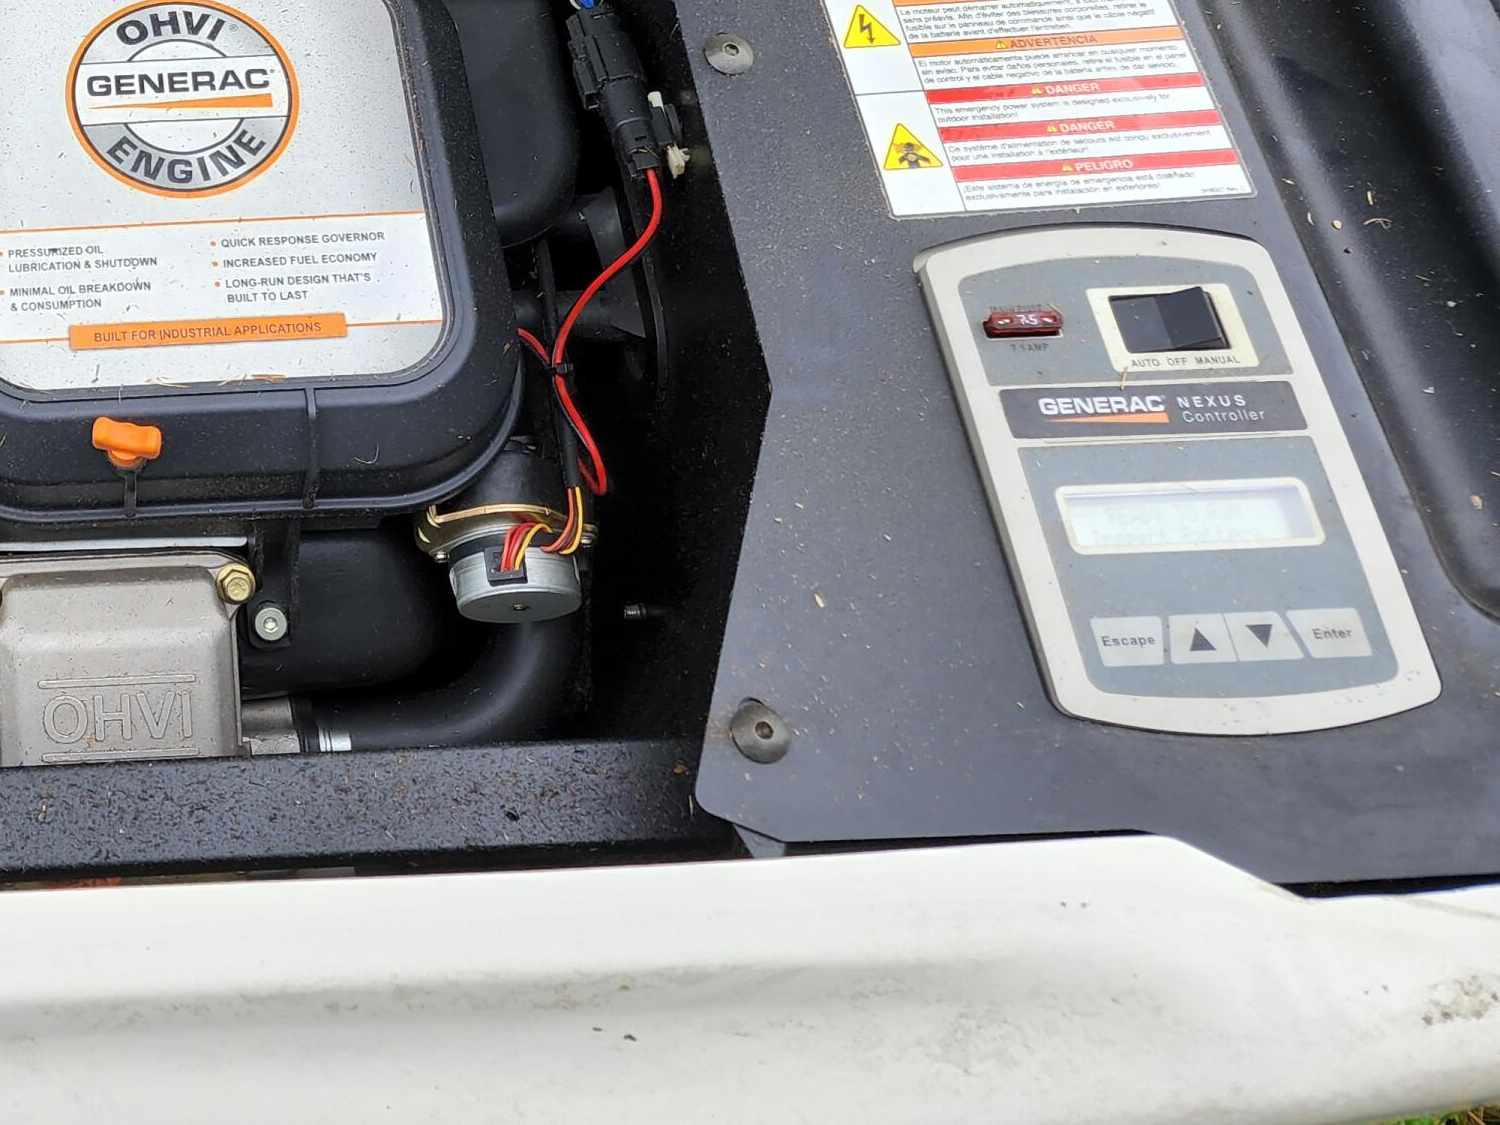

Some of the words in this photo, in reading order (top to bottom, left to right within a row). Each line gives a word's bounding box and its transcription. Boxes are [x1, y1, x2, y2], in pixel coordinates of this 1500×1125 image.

[1008, 35, 1098, 48] ADVERTENCIA
[87, 69, 270, 97] GENERAC
[1044, 83, 1100, 94] DANGER
[1059, 120, 1115, 131] DANGER
[107, 129, 266, 184] ENGINE
[1074, 159, 1134, 171] PELIGRO
[220, 236, 255, 247] QUICK
[258, 234, 318, 245] RESPONSE
[321, 231, 384, 242] GOVERNOR
[8, 246, 82, 258] PRESSURIZED
[85, 245, 103, 254] OIL
[223, 255, 286, 267] INCREASED
[289, 255, 318, 264] FUEL
[321, 252, 376, 263] ECONOMY
[8, 259, 80, 272] LUBRICATION
[84, 260, 91, 268] &
[94, 256, 157, 268] SHUTDOWN
[9, 286, 54, 296] MINIMAL
[57, 285, 75, 296] OIL
[78, 280, 150, 293] BREAKDOWN
[225, 276, 283, 288] LONG-RUN
[287, 274, 328, 285] DESIGN
[332, 272, 370, 282] THAT'S
[227, 292, 257, 302] BUILT
[261, 291, 276, 300] TO
[279, 290, 307, 300] LAST
[10, 302, 17, 311] &
[21, 298, 101, 310] CONSUMPTION
[1017, 314, 1038, 325] 7.5
[93, 331, 127, 343] BUILT
[131, 329, 156, 341] FOR
[159, 326, 231, 340] INDUSTRIAL
[234, 322, 321, 335] APPLICATIONS
[1131, 358, 1160, 368] AUTO
[1167, 357, 1187, 367] OFF
[1195, 355, 1241, 365] MANUAL
[1038, 395, 1166, 415] GENERAC
[1177, 394, 1246, 408] NEXUS
[1182, 408, 1265, 424] Controller
[1102, 633, 1156, 649] Escape
[1312, 625, 1353, 641] Enter
[43, 690, 193, 744] OHVI
